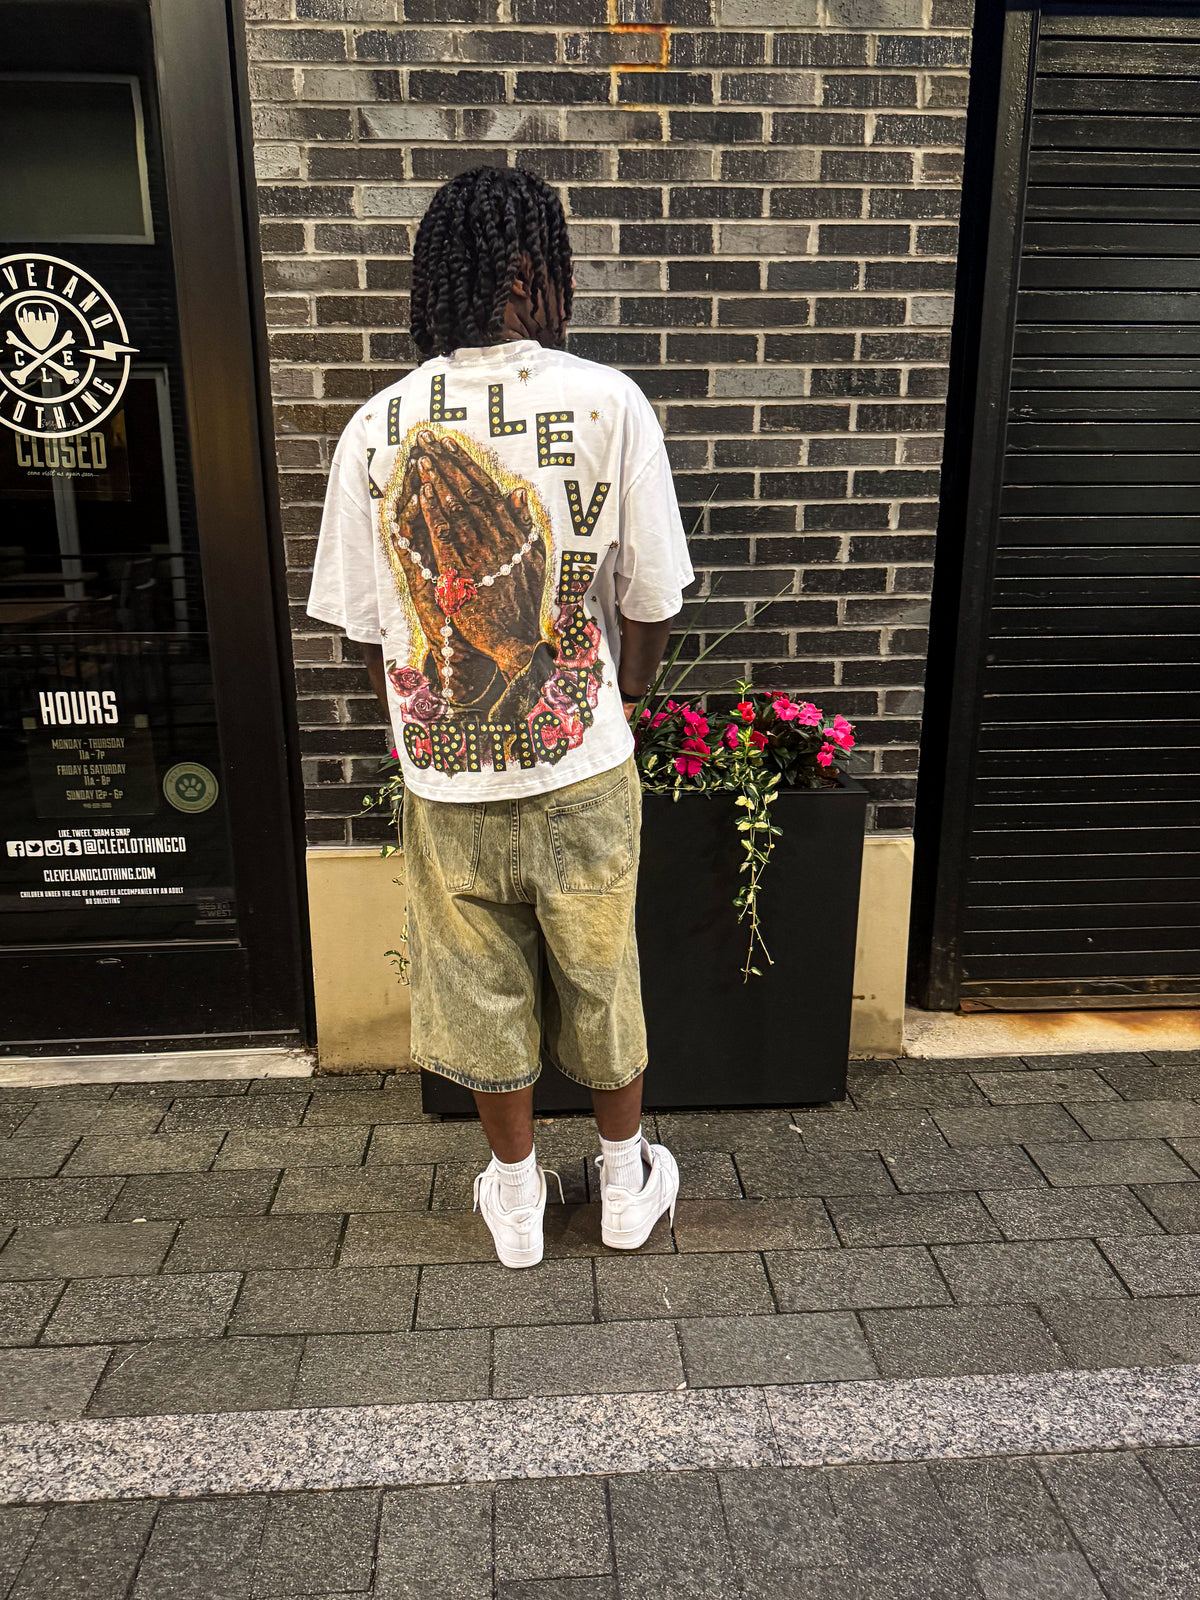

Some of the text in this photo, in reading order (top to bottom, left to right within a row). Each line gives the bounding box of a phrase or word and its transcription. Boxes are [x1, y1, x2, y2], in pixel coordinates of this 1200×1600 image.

[0, 263, 113, 329] VELAND
[15, 431, 107, 469] CLOSED
[39, 690, 119, 725] HOURS
[51, 738, 82, 750] MONDAY
[88, 737, 125, 749] THURSDAY
[402, 710, 569, 773] CRITIC
[79, 749, 90, 760] 11A
[95, 749, 105, 760] 7P
[57, 765, 82, 776] FRIDAY
[89, 763, 126, 775] SATURDAY
[84, 775, 96, 786] 11A
[101, 775, 111, 786] 8P
[66, 789, 95, 800] SUNDAY
[95, 789, 108, 800] 12P
[113, 789, 124, 799] 6P
[115, 827, 131, 837] SNAP
[83, 837, 187, 855] @CLECLOTHINGCO
[43, 867, 157, 883] CLEVELANDCLOTHING.COM
[20, 890, 45, 898] CHILDREN
[44, 890, 61, 898] UNDER
[82, 889, 89, 897] OF
[95, 889, 110, 897] MUST
[117, 887, 153, 896] ACCOMPANIED
[152, 887, 160, 895] BY
[93, 897, 120, 905] SOLICITING
